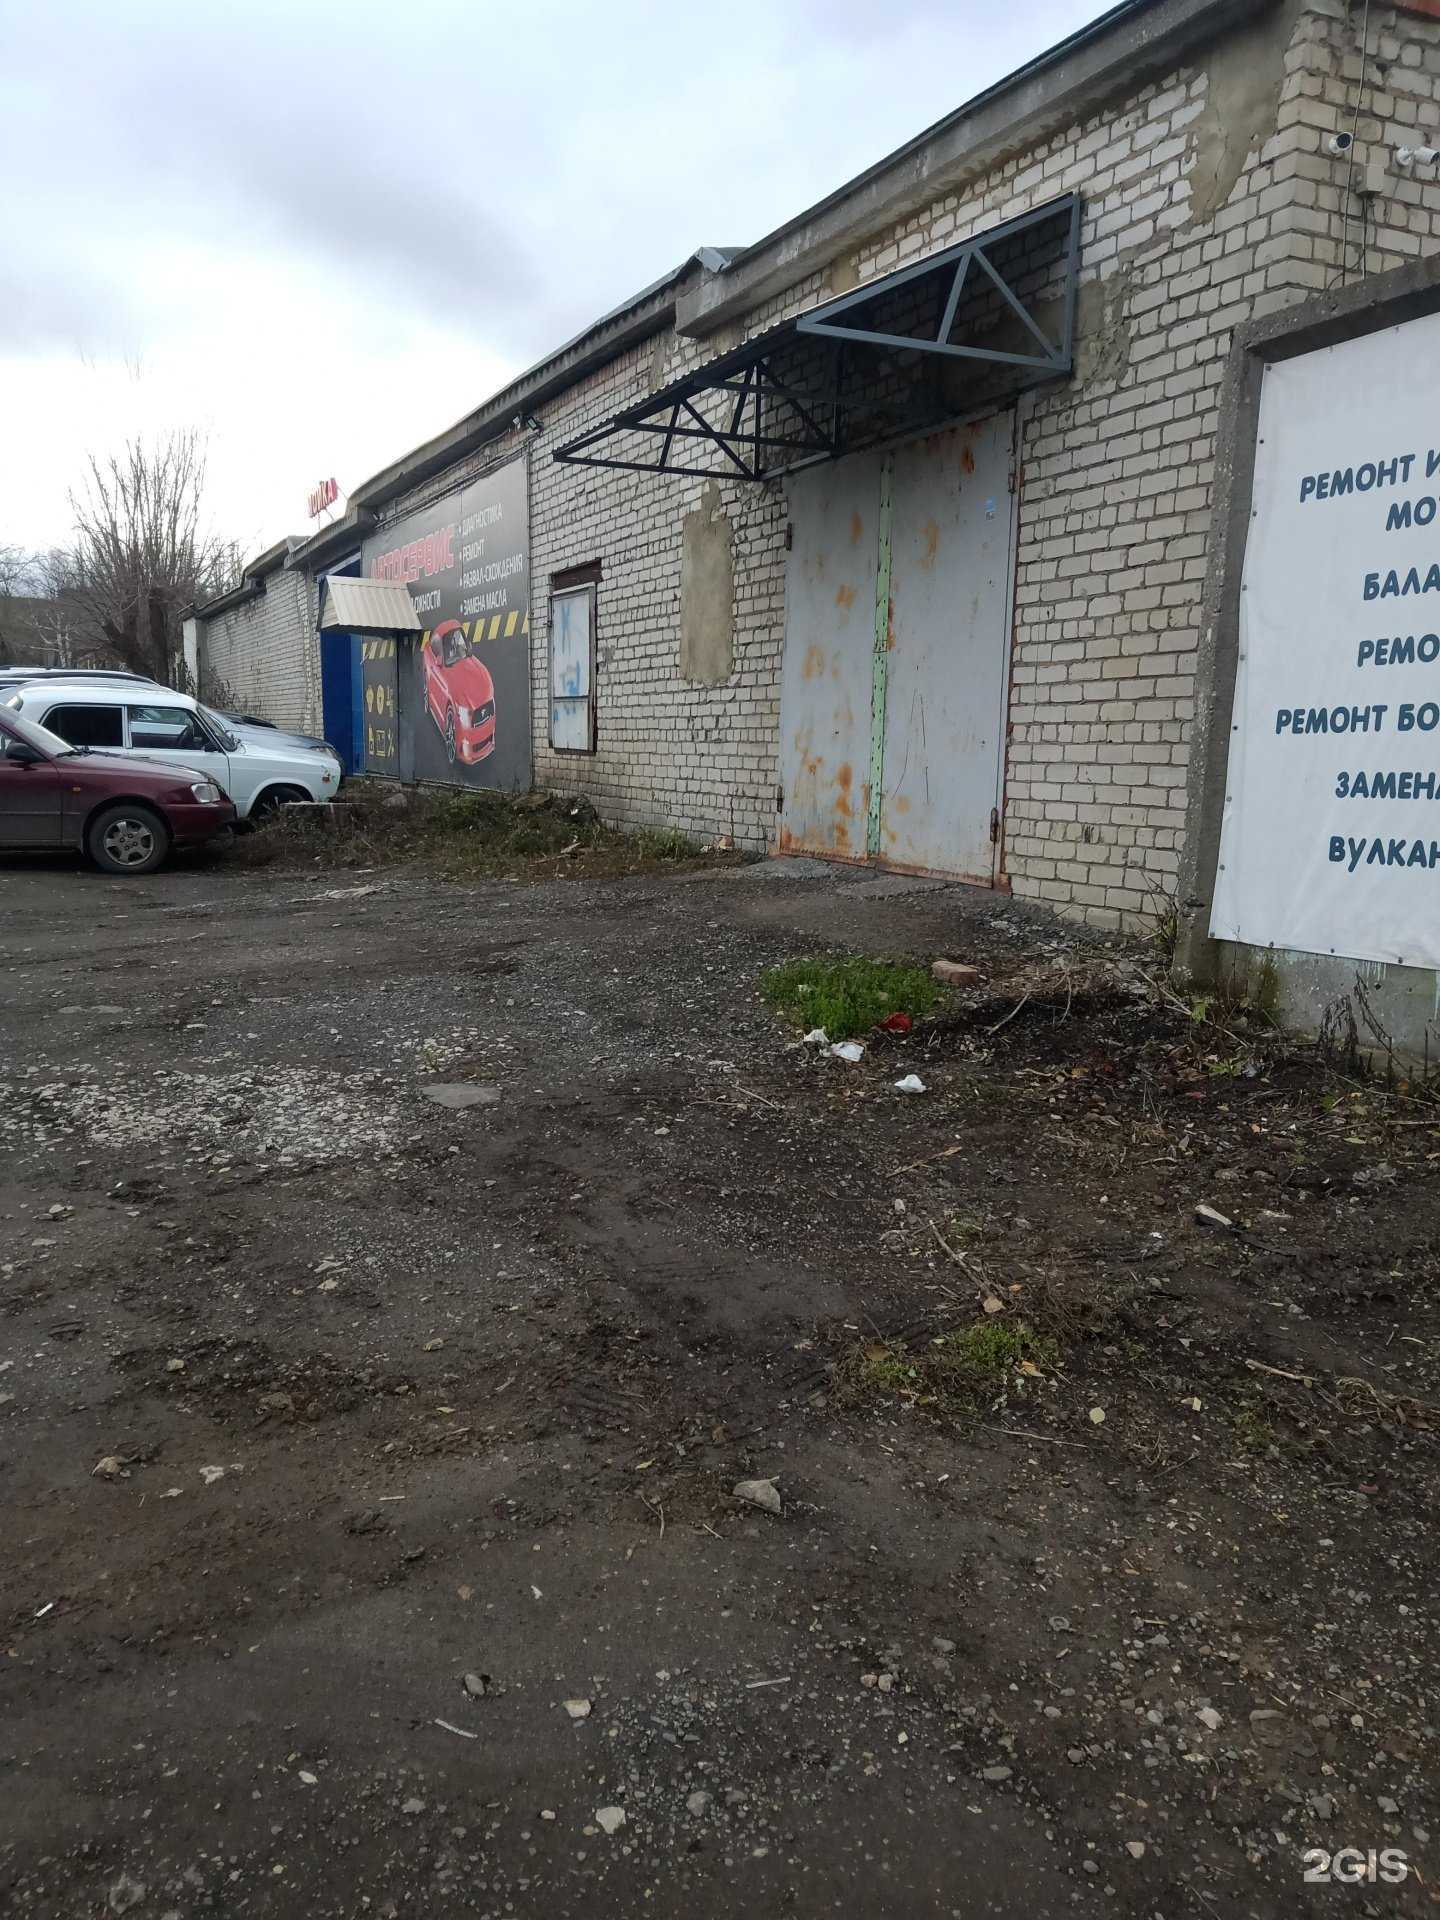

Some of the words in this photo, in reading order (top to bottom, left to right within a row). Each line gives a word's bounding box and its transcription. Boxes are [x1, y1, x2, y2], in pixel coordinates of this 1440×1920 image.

[1299, 453, 1416, 503] РЕМОНТ
[462, 503, 504, 536] ДИАГНОСТИКА
[1385, 496, 1440, 532] МО
[369, 524, 456, 584] АВТОСЕРВИС
[462, 538, 486, 562] РЕМОНТ
[463, 553, 524, 589] РАЗВАЛ-СХОЖДЕНИЯ
[463, 594, 486, 616] ЗАМЕНА
[486, 588, 508, 610] МАСЛА
[1357, 633, 1440, 668] РЕМО
[1275, 704, 1388, 735] РЕМОНТ
[1397, 702, 1440, 732] БО
